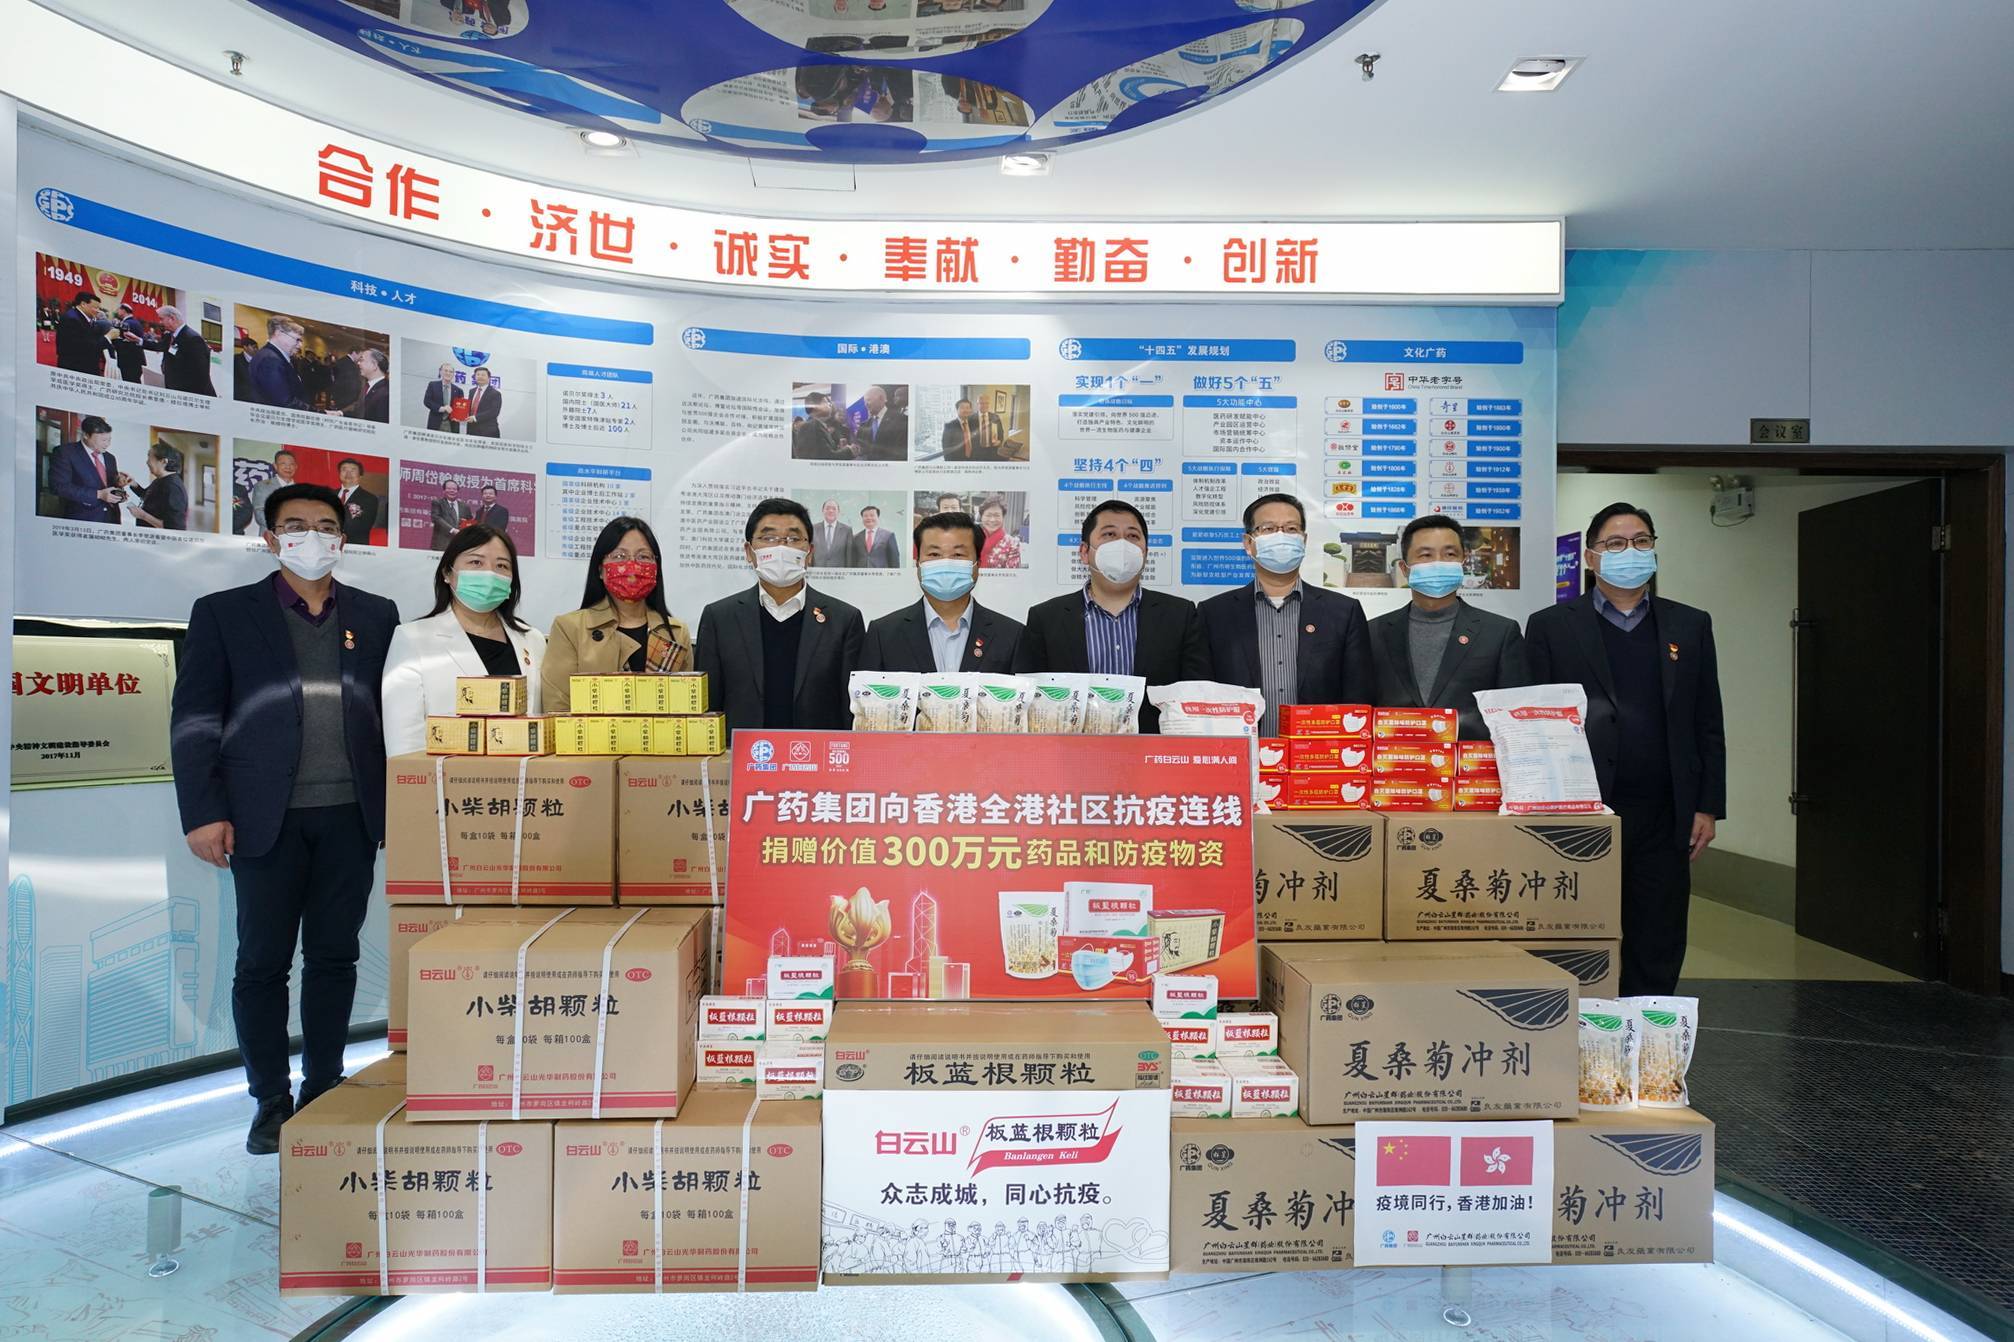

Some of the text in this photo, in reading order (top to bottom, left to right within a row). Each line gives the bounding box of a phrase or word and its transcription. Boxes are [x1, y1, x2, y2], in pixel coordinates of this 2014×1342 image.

[318, 143, 1319, 284] 合作 济世 诚实 奉献 勤奋 创新
[48, 266, 83, 287] 1949
[1186, 345, 1231, 357] 发展规划
[1403, 347, 1447, 358] 文化广药
[1408, 375, 1463, 385] 中华老字号
[1216, 398, 1263, 406] 5大功能中心
[1760, 425, 1804, 439] 会议室
[41, 751, 81, 760] 2017年11月
[829, 752, 849, 764] 500
[1145, 755, 1189, 764] 广药白云山
[397, 774, 591, 786] 白云山 OTC
[628, 778, 657, 787] 白云山
[742, 792, 1242, 827] 广药集团向香港全港社区抗疫连线
[762, 835, 1224, 870] 捐赠价值300万元药品和防疫物资
[1416, 867, 1579, 903] 夏桑菊冲剂
[398, 923, 428, 933] 白云山
[420, 969, 651, 981] 白云山 OTC
[544, 1034, 591, 1044] 每箱100盒
[835, 1050, 865, 1061] 白云山
[1342, 1040, 1531, 1081] 夏桑菊冲剂
[904, 1062, 1096, 1086] 板蓝根颗粒
[985, 1122, 1101, 1144] 板蓝根颗粒
[875, 1130, 957, 1155] 白云山
[291, 1145, 521, 1157] 白云山 OTC
[566, 1145, 791, 1156] 白云山 OTC
[1003, 1150, 1078, 1161] Banlangen Keli
[1558, 1184, 1664, 1226] 菊冲剂
[416, 1209, 464, 1220] 每箱100盒
[687, 1209, 734, 1219] 每箱100盒
